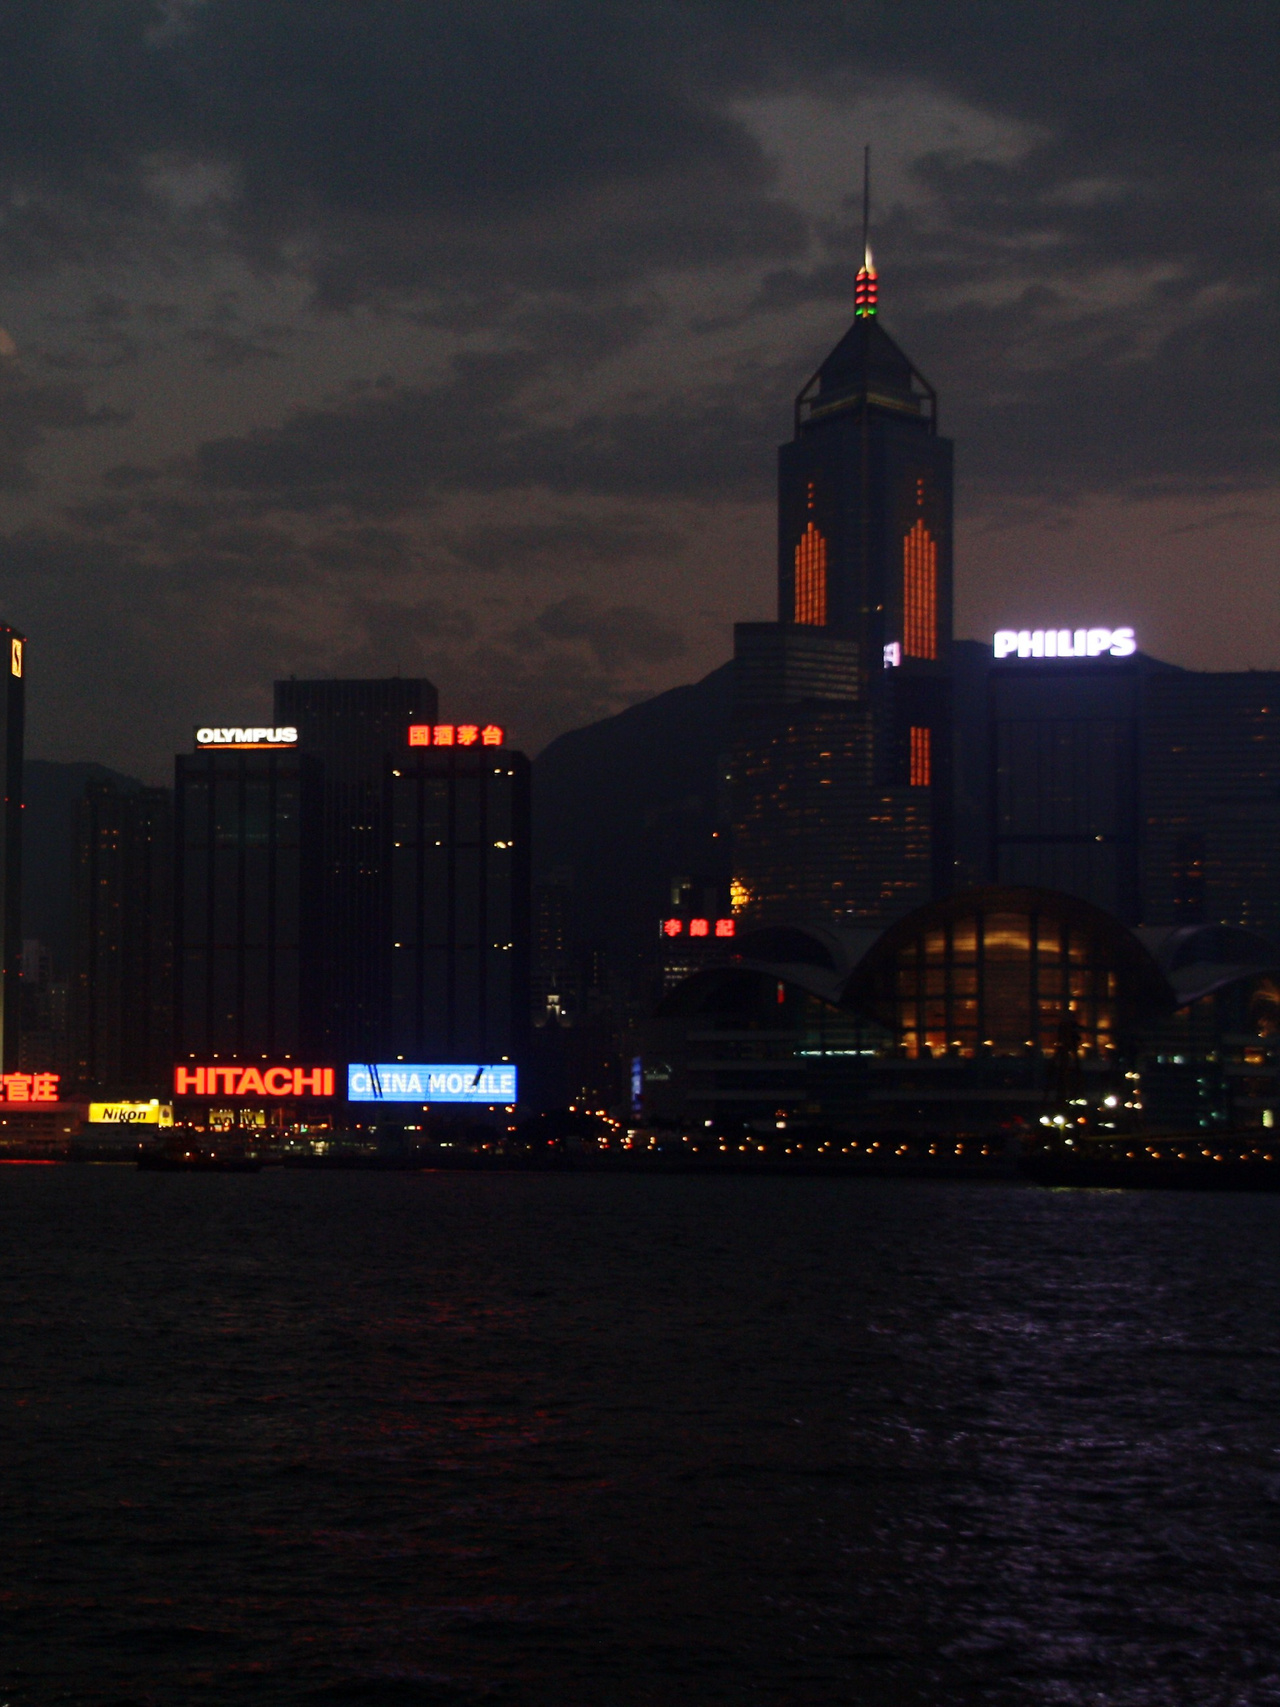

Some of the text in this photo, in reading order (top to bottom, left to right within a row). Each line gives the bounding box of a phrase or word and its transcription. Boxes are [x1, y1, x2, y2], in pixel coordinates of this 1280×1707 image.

[993, 628, 1136, 659] PHILIPS
[196, 727, 298, 744] OLYMPUS
[175, 1066, 335, 1096] HITACHI
[102, 1107, 147, 1120] Nikon
